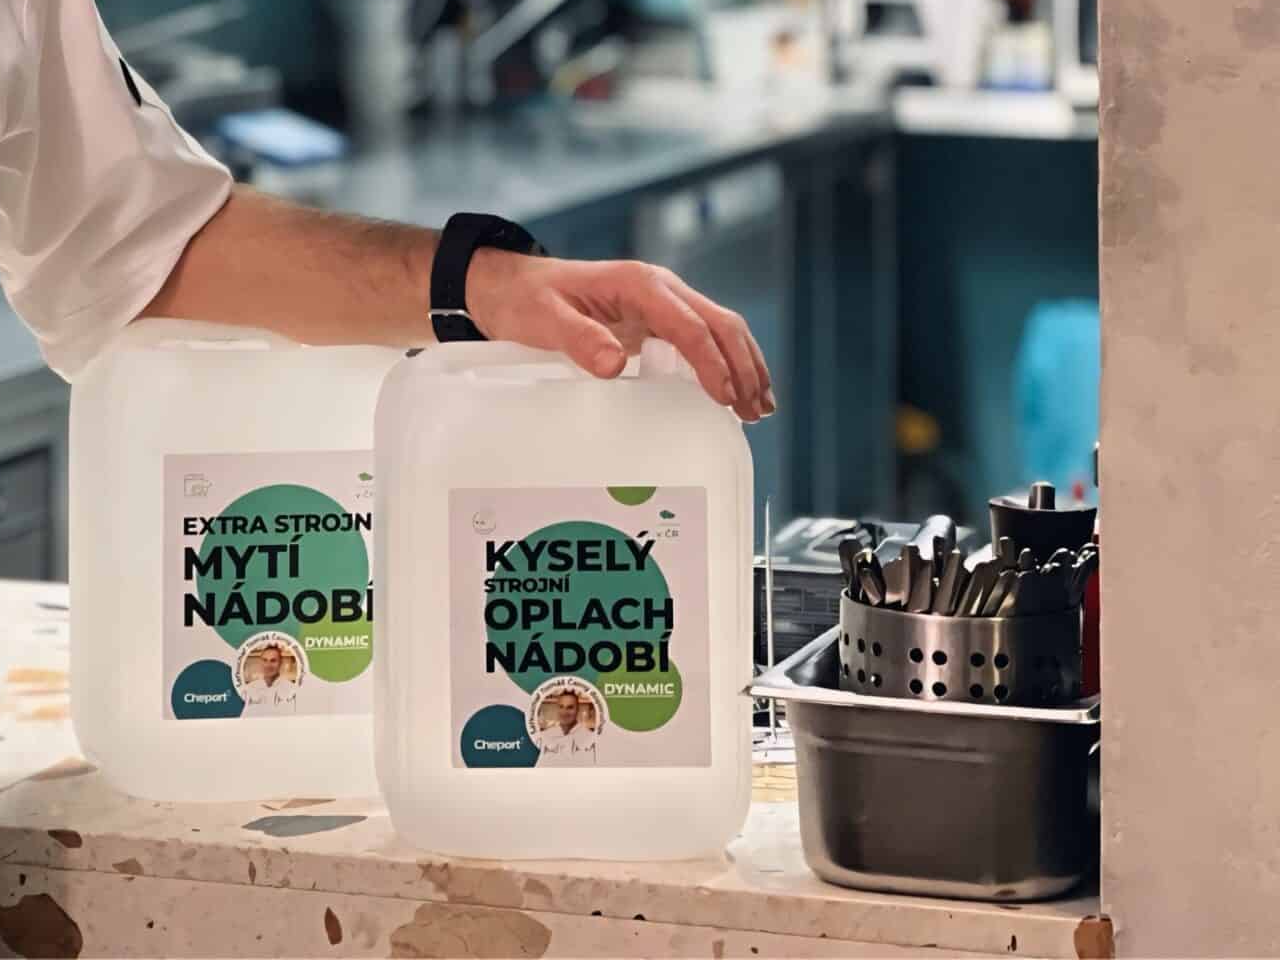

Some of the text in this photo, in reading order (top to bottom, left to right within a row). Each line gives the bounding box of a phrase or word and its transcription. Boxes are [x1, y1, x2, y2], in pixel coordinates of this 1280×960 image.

[183, 513, 372, 536] EXTRA STROJN
[183, 534, 301, 581] MYTÍ
[484, 530, 656, 573] KYSELÝ
[484, 573, 571, 593] STROJNÍ
[183, 581, 374, 627] NÁDOBÍ
[484, 597, 675, 631] OPLACH
[304, 635, 370, 649] DYNAMIC
[485, 632, 671, 674] NÁDOBÍ
[603, 681, 675, 696] DYNAMIC
